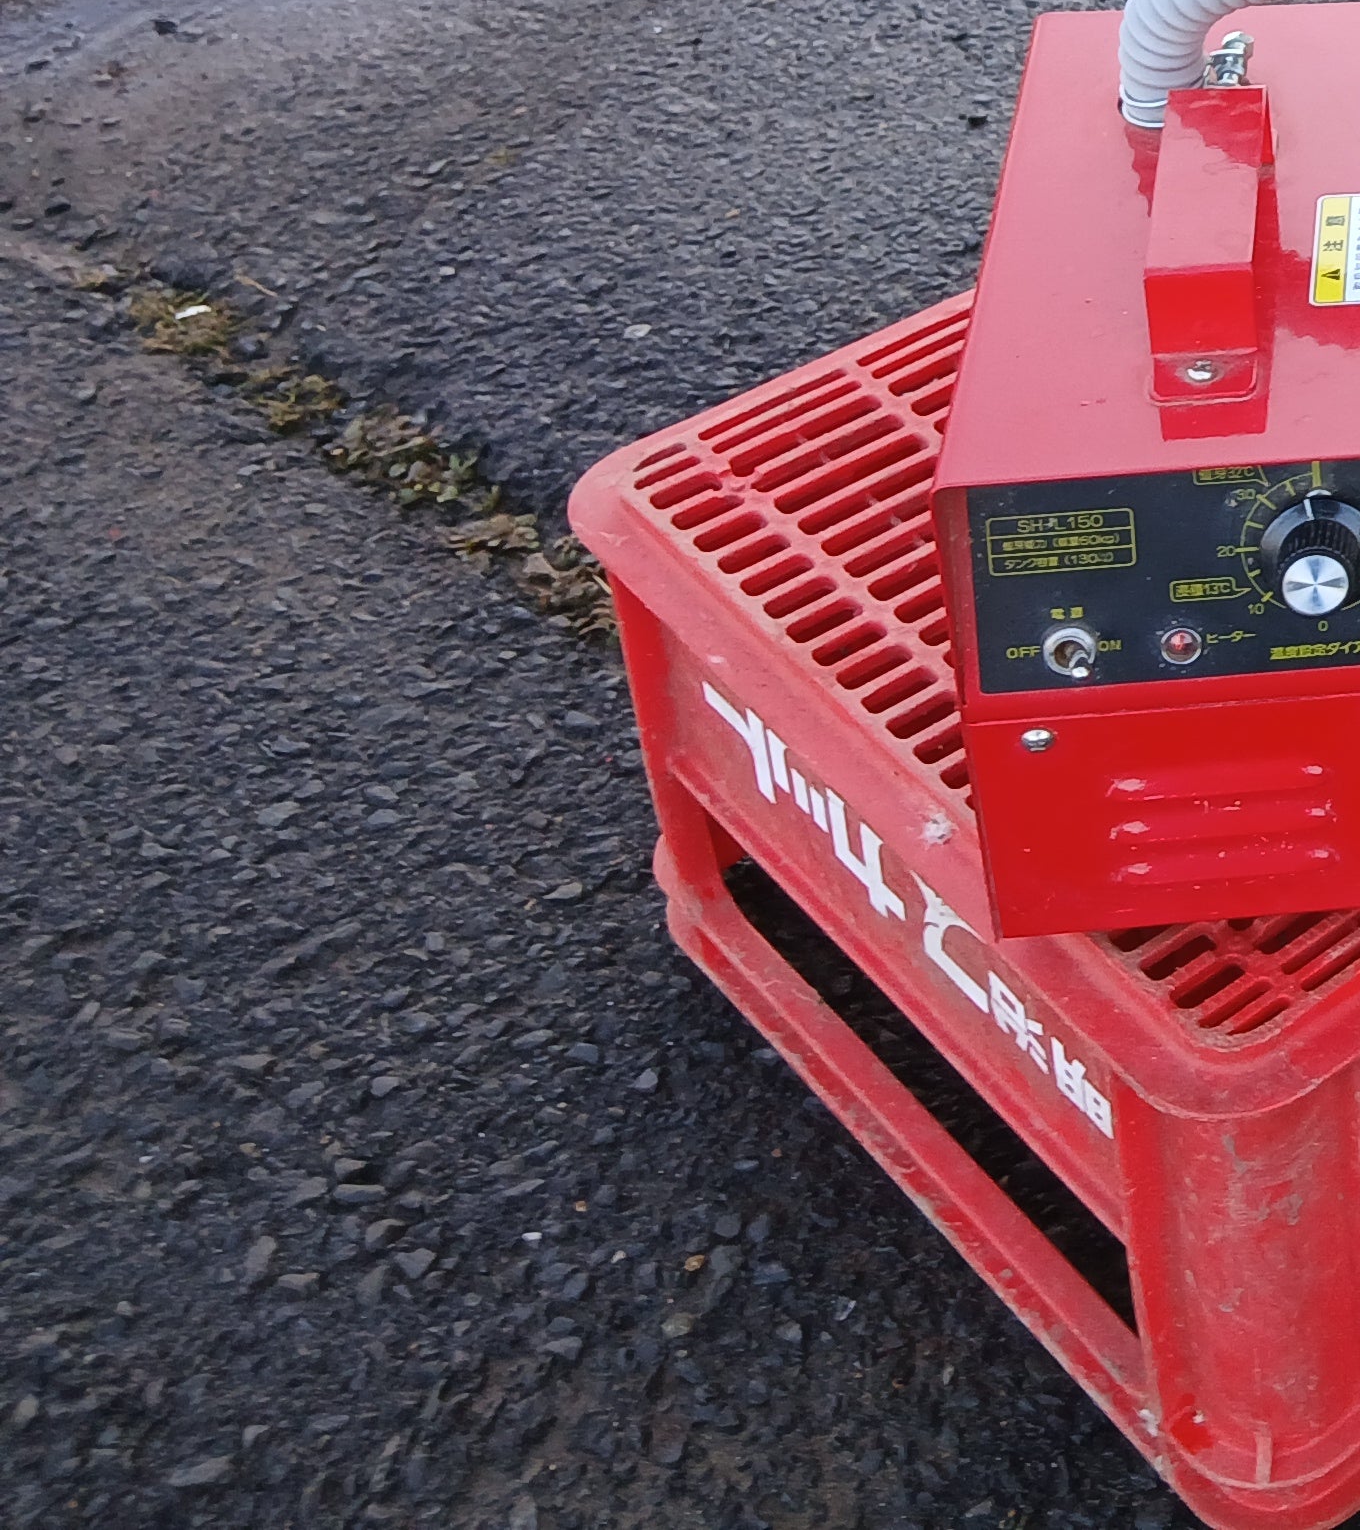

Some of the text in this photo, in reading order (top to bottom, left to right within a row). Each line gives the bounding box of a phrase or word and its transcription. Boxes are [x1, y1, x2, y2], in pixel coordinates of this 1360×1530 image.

[1216, 545, 1236, 558] 20
[1247, 602, 1265, 616] 10
[1206, 630, 1257, 644] ヒーター
[1006, 639, 1122, 660] OFF ON
